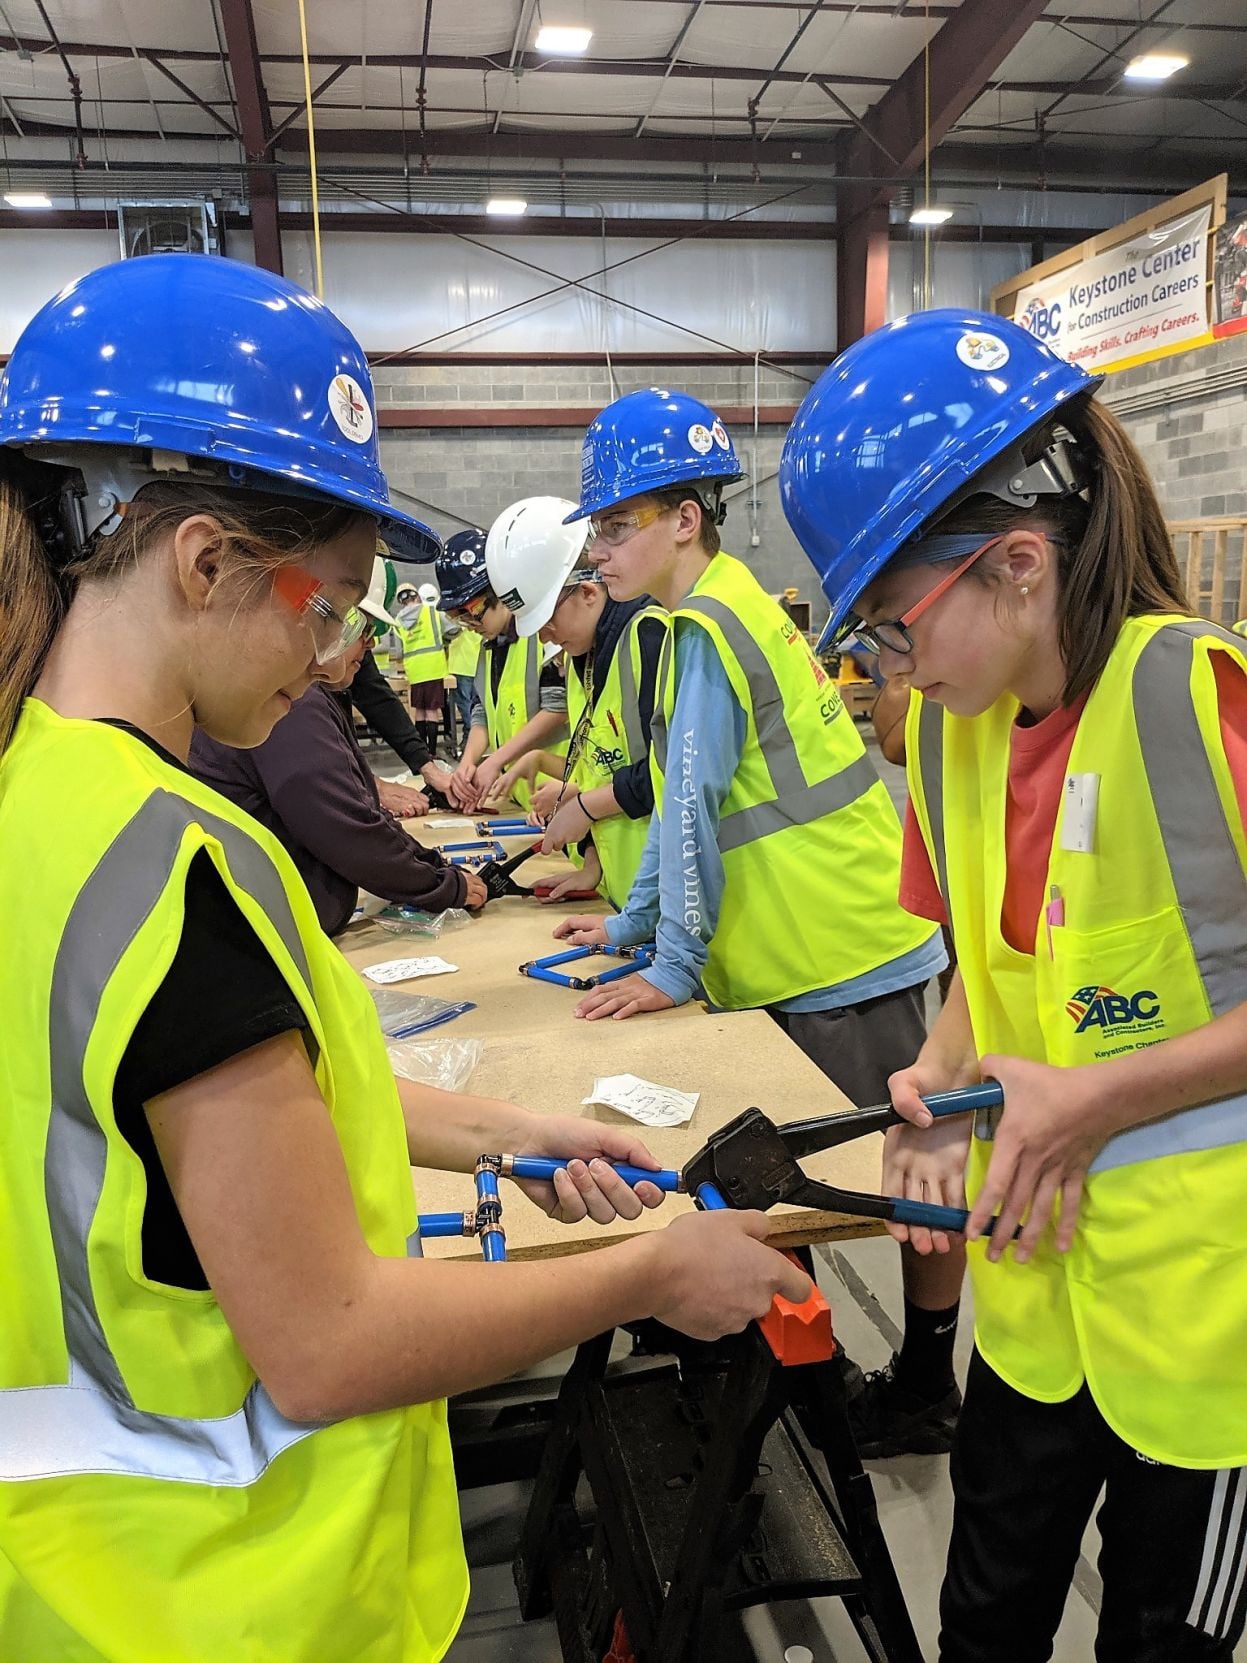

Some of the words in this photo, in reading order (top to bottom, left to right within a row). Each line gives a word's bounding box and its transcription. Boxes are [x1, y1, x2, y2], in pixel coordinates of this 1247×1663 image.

[1069, 266, 1136, 308] Keystone
[1142, 240, 1200, 278] Center
[1028, 303, 1061, 339] ABC
[1067, 321, 1077, 334] for
[1078, 294, 1148, 329] Construction
[1152, 274, 1199, 302] Careers
[1068, 346, 1098, 361] Building
[1099, 336, 1122, 352] Skills.
[1124, 325, 1158, 344] Crafting
[1161, 312, 1199, 332] Careers.
[595, 747, 624, 766] ABC
[673, 728, 701, 860] vineyard
[683, 862, 701, 938] vines
[1074, 990, 1160, 1033] ABC
[1094, 1044, 1134, 1058] Keystone
